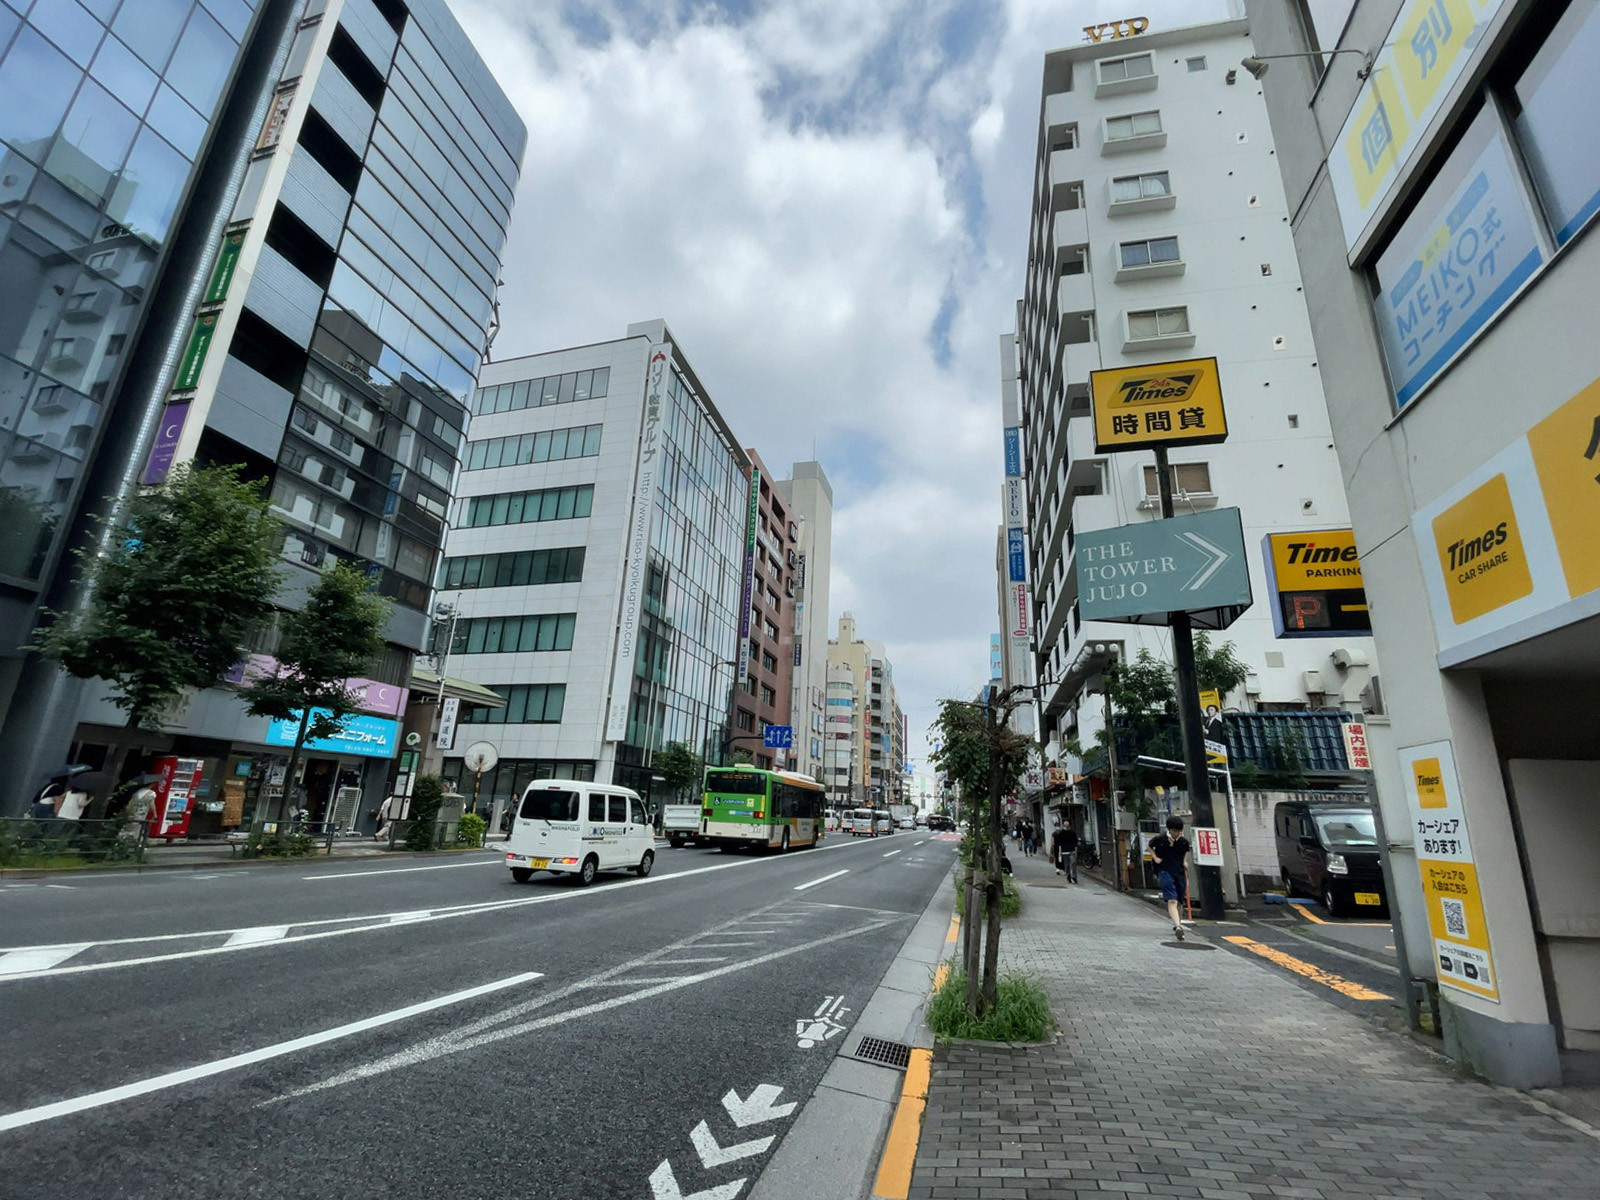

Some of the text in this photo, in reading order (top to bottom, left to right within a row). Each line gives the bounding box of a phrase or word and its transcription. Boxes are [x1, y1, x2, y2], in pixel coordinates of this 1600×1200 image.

[1082, 16, 1149, 43] VIP
[1404, 235, 1505, 367] コーチング
[1119, 379, 1194, 403] Times
[1112, 406, 1206, 435] 時間貸
[1084, 541, 1134, 562] THE
[1287, 543, 1357, 564] Time
[1447, 522, 1507, 571] Times
[1084, 556, 1177, 583] TOWER
[1458, 551, 1508, 584] CAR SHARE
[1086, 581, 1148, 603] JUJO
[1294, 597, 1321, 628] P
[1348, 724, 1370, 768] 場内禁煙
[1417, 775, 1440, 786] Times
[1418, 819, 1459, 834] カーシェア
[1429, 869, 1465, 881] カーシェアの
[1432, 880, 1468, 894] 入会はこちら
